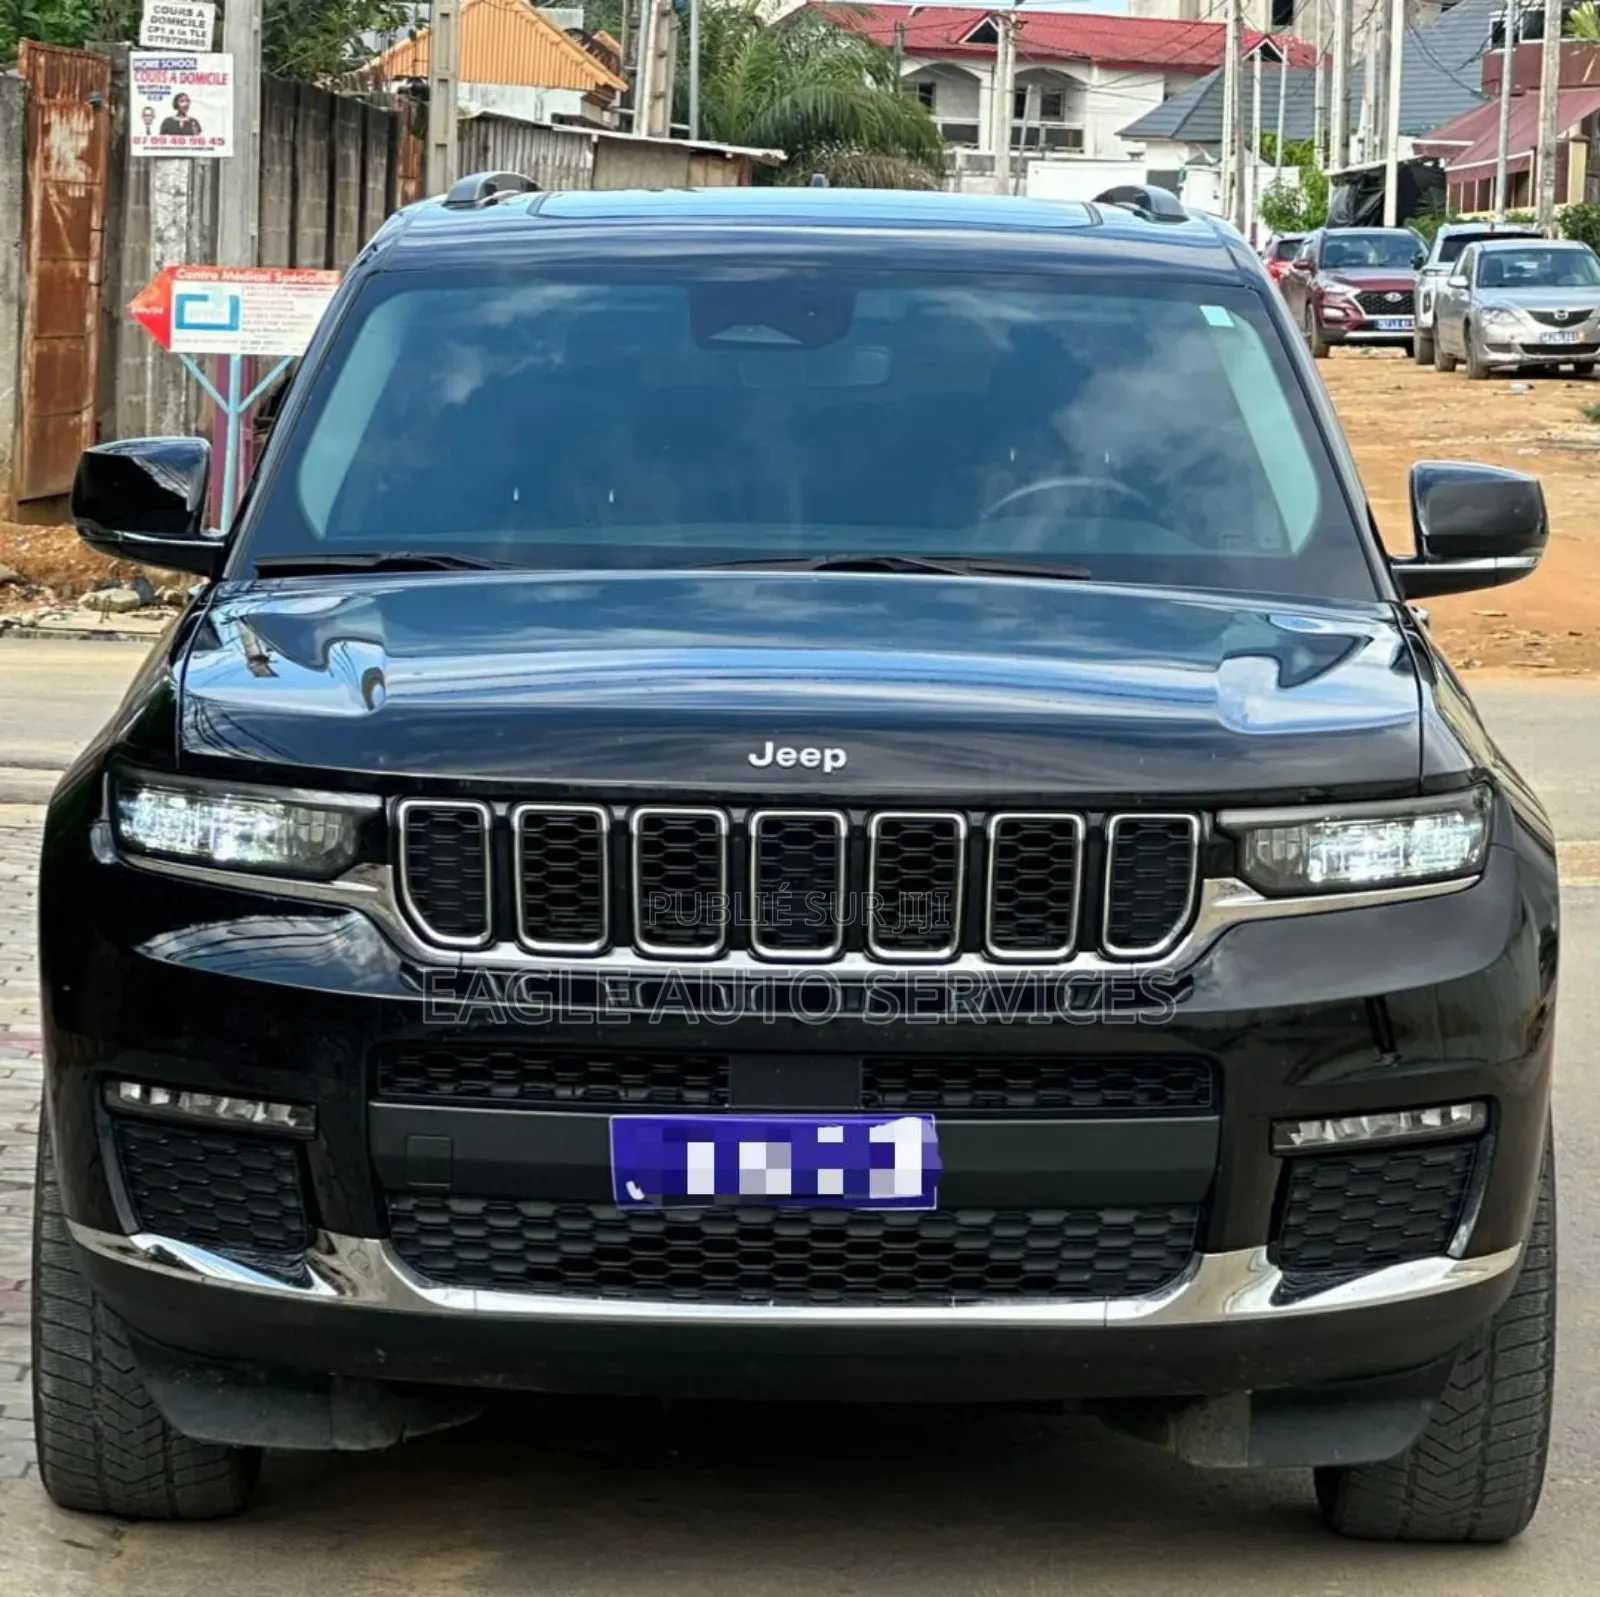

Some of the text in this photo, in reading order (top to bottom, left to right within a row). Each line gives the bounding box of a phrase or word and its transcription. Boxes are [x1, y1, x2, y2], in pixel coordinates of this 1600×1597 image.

[153, 5, 193, 17] COURS
[150, 14, 206, 29] DOMICILE
[147, 25, 165, 34] CP1
[190, 29, 207, 38] TLE
[160, 59, 197, 69] SCHOOL
[134, 70, 228, 85] COURS A DOMICILE
[176, 268, 219, 281] Centre
[221, 269, 271, 283] Médical
[748, 741, 847, 773] Jeep
